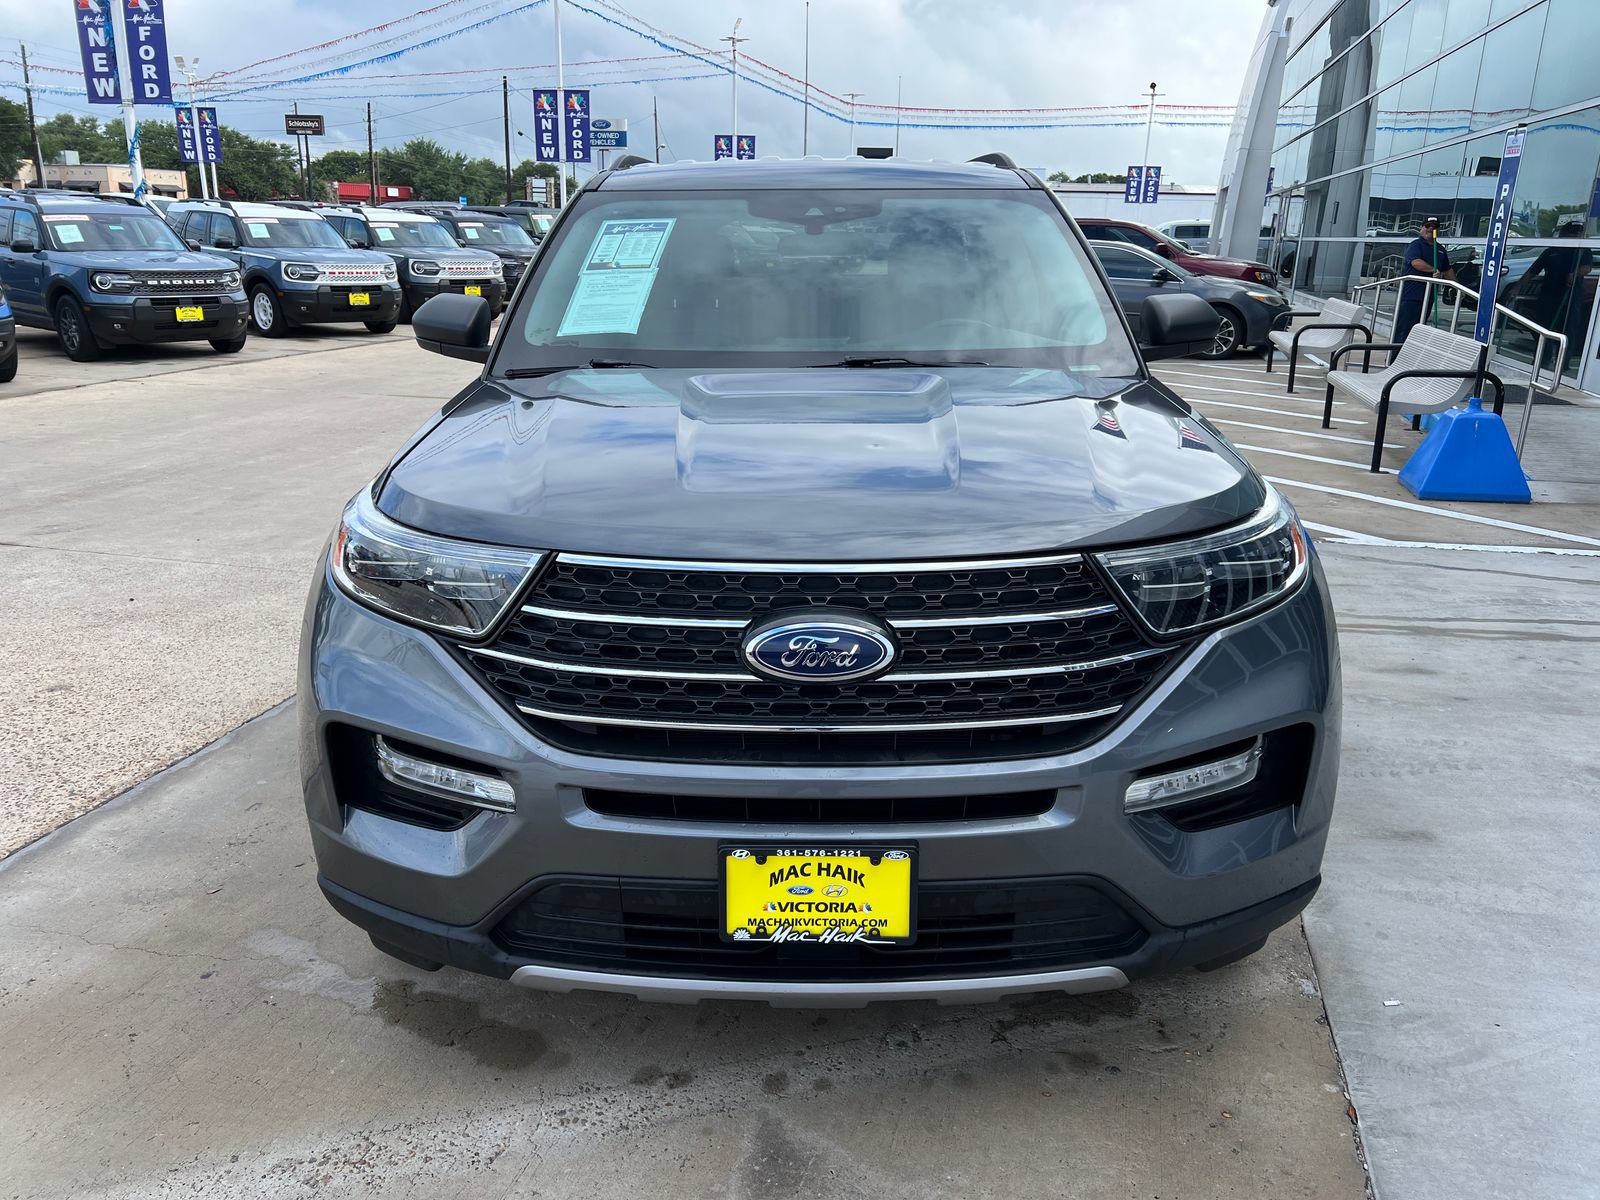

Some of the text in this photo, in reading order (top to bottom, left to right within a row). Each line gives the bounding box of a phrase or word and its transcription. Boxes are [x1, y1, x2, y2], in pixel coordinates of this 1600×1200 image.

[87, 27, 115, 97] NEW
[138, 26, 160, 98] FORD
[182, 129, 195, 160] NEW
[205, 129, 216, 160] FORD
[541, 118, 555, 158] NEW
[572, 118, 583, 159] FORD
[1128, 181, 1138, 202] NEW
[1147, 180, 1155, 202] FORD
[1487, 183, 1510, 277] PARTS
[781, 635, 859, 668] Ford
[776, 849, 861, 857] 361-576-1221
[769, 862, 866, 888] MAC HAIK
[747, 917, 888, 928] MACHAIKVICTORIA.COM
[777, 901, 858, 913] VICTORIA
[767, 925, 880, 944] Mac Haik
